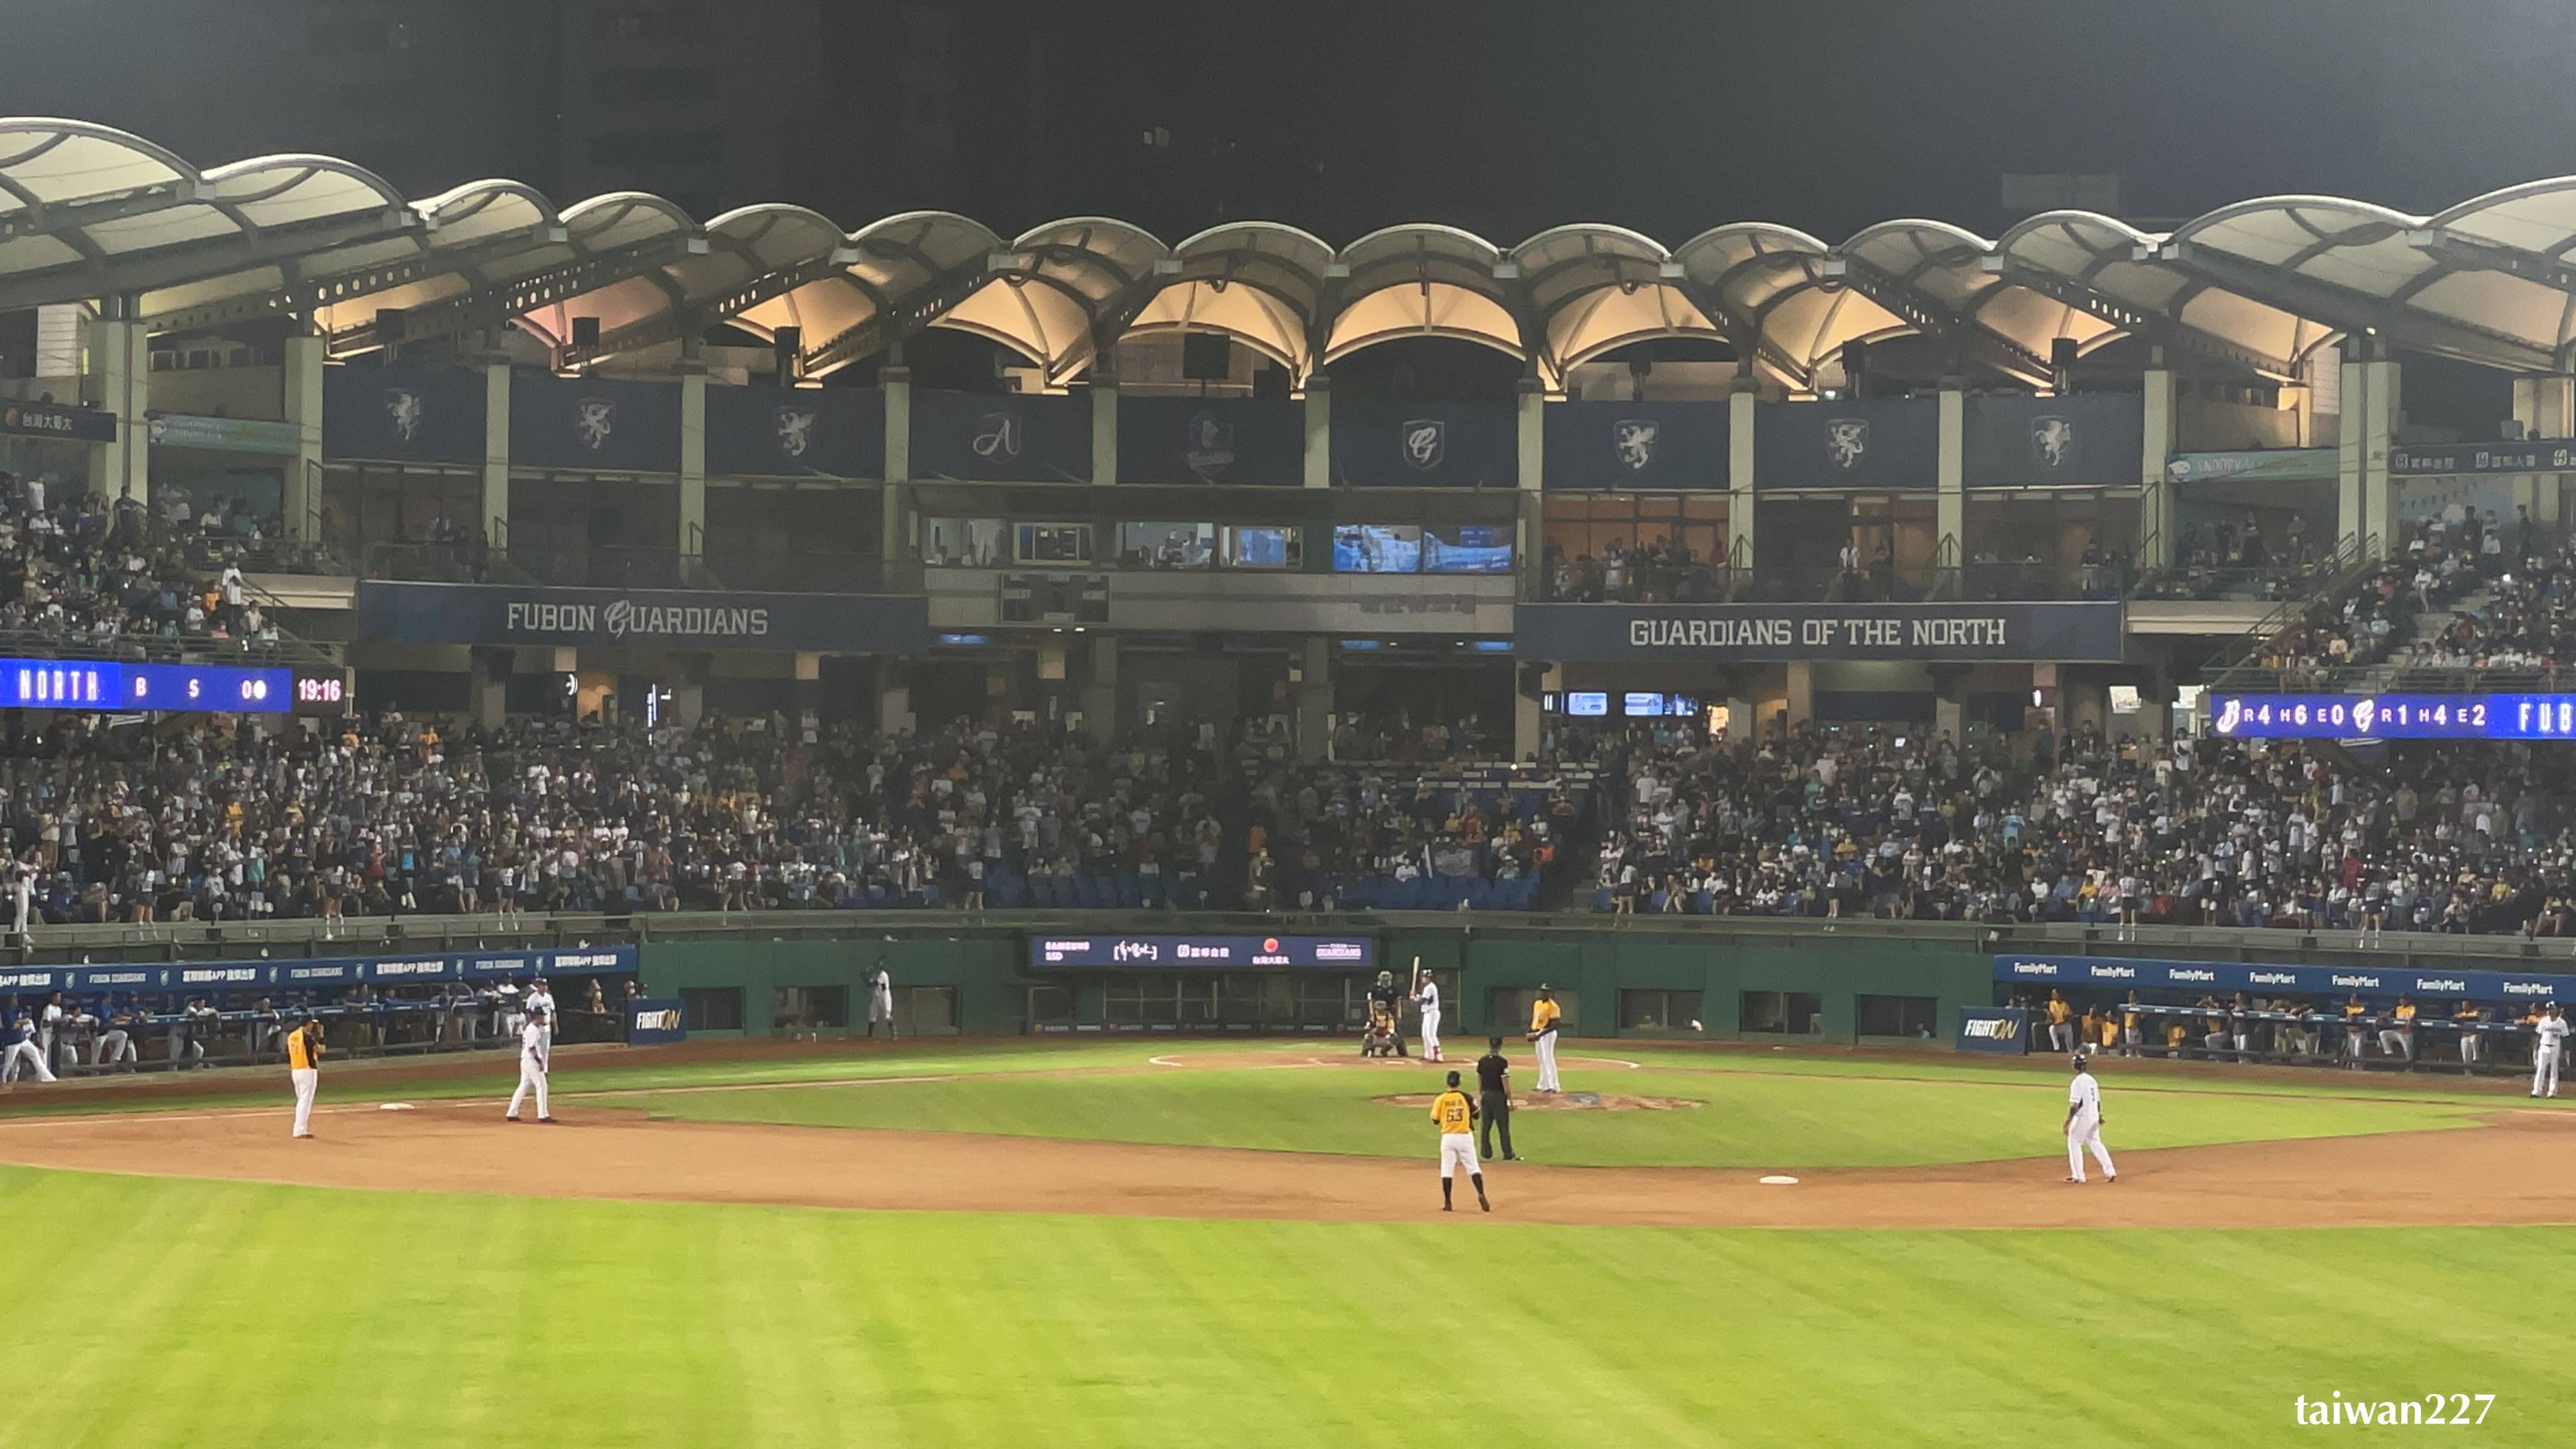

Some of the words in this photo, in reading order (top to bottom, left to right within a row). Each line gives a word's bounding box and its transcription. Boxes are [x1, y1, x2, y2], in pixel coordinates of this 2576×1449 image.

[506, 602, 596, 632] FUBON
[604, 599, 768, 638] GUARDIANS
[1630, 618, 1793, 646] GUARDIANS
[1802, 619, 1838, 645] OF
[1843, 619, 1901, 645] THE
[1912, 618, 2007, 645] NORTH
[19, 669, 98, 702] NORTH
[298, 678, 342, 702] 19:16
[2518, 702, 2575, 733] FUB
[2014, 962, 2057, 974] FamilyMart
[2091, 965, 2135, 978] FamilyMart
[2169, 968, 2214, 981] FamilyMart
[2250, 972, 2296, 985] FamilyMart
[2332, 975, 2379, 988] FamilyMart
[2416, 978, 2465, 992] FamilyMart
[2504, 982, 2553, 995] FamilyMart
